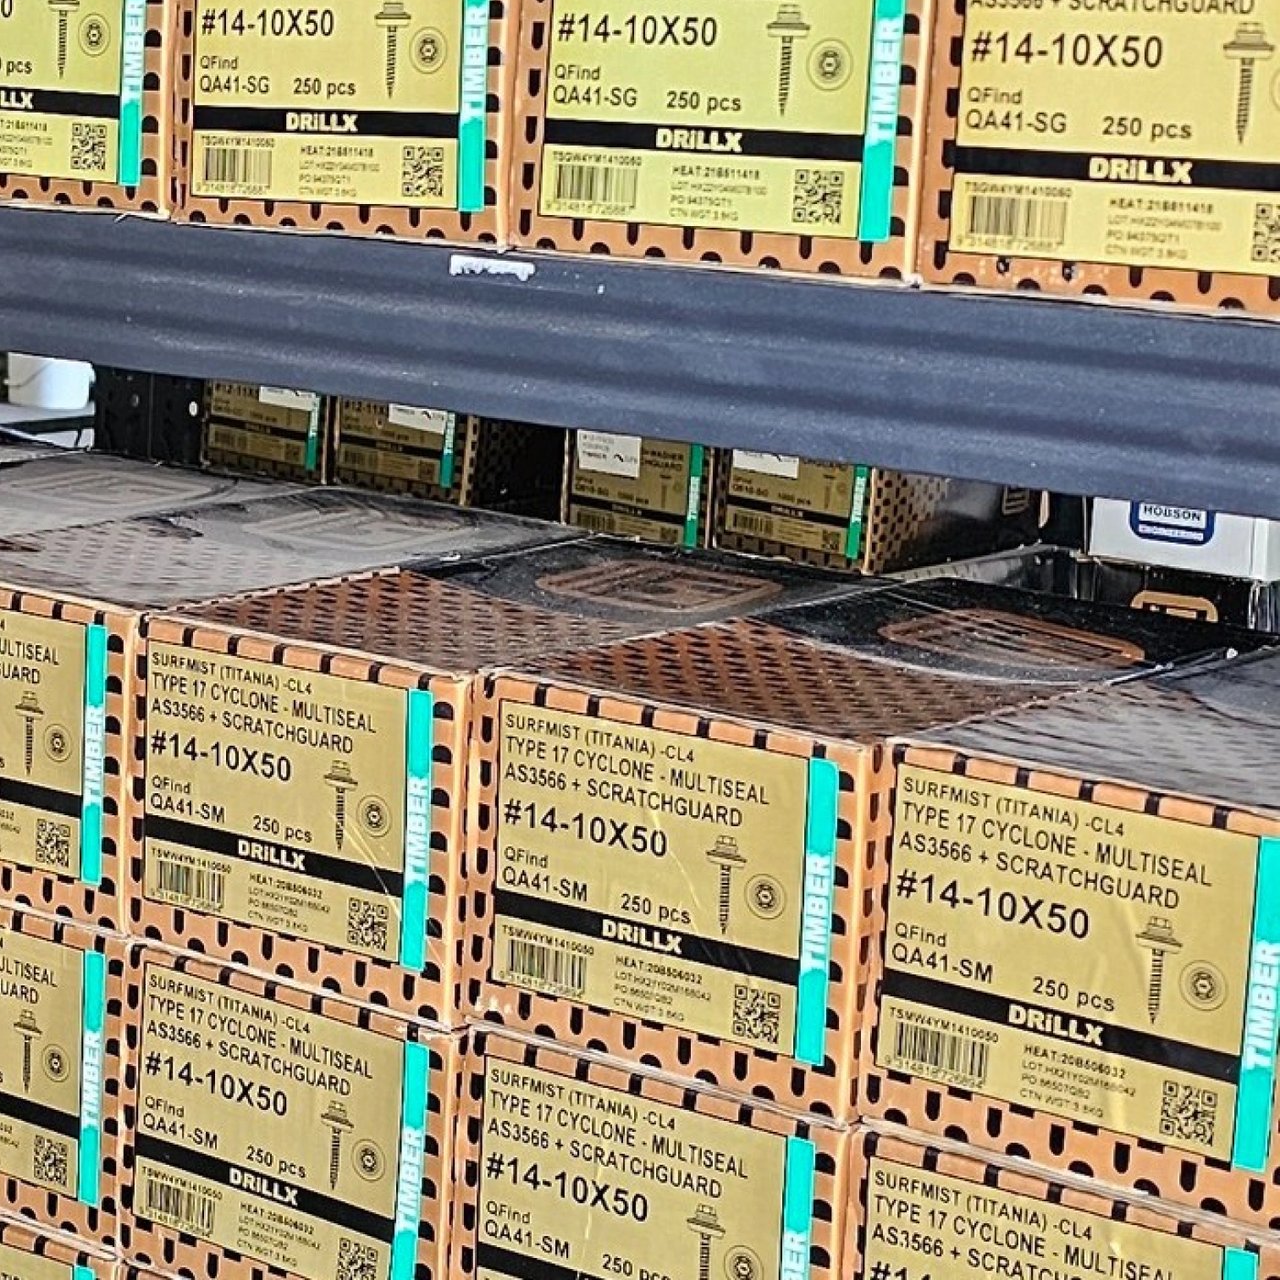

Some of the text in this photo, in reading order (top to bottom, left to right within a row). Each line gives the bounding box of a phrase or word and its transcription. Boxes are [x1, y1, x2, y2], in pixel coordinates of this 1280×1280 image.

[201, 8, 334, 36] #14-10X50
[556, 12, 718, 47] #14-10X50
[554, 64, 600, 81] QFind
[970, 30, 1164, 70] #14-10X50
[552, 83, 742, 115] QA41-SG 250 pcs
[967, 87, 1022, 106] QFind
[964, 108, 1192, 144] QA41-SG 250 pcs
[1144, 505, 1202, 522] HOBSON
[152, 727, 291, 783] #14-10X50
[222, 709, 353, 754] SCRATCHGUARD
[151, 790, 312, 847] QA41-SM 250 pcs
[503, 796, 668, 858] #14-10X50
[902, 776, 990, 811] SURFMIST
[995, 796, 1079, 832] (TITANIA)
[900, 800, 949, 830] TYPE
[956, 813, 976, 835] 17
[980, 817, 1077, 858] CYCLONE
[1094, 842, 1213, 888] MULTISEAL
[899, 828, 973, 864] AS3566
[995, 849, 1179, 911] SCRATCHGUARD
[896, 866, 1090, 941] #14-10X50
[895, 920, 947, 948] QFind
[150, 973, 278, 1028] SURFMIST (TITANIA)
[891, 940, 1116, 1017] QA41-SM 250 pcs
[146, 1048, 287, 1118] #14-10X50
[143, 1110, 218, 1152] QA41-SM
[486, 1149, 649, 1224] #14-10X50
